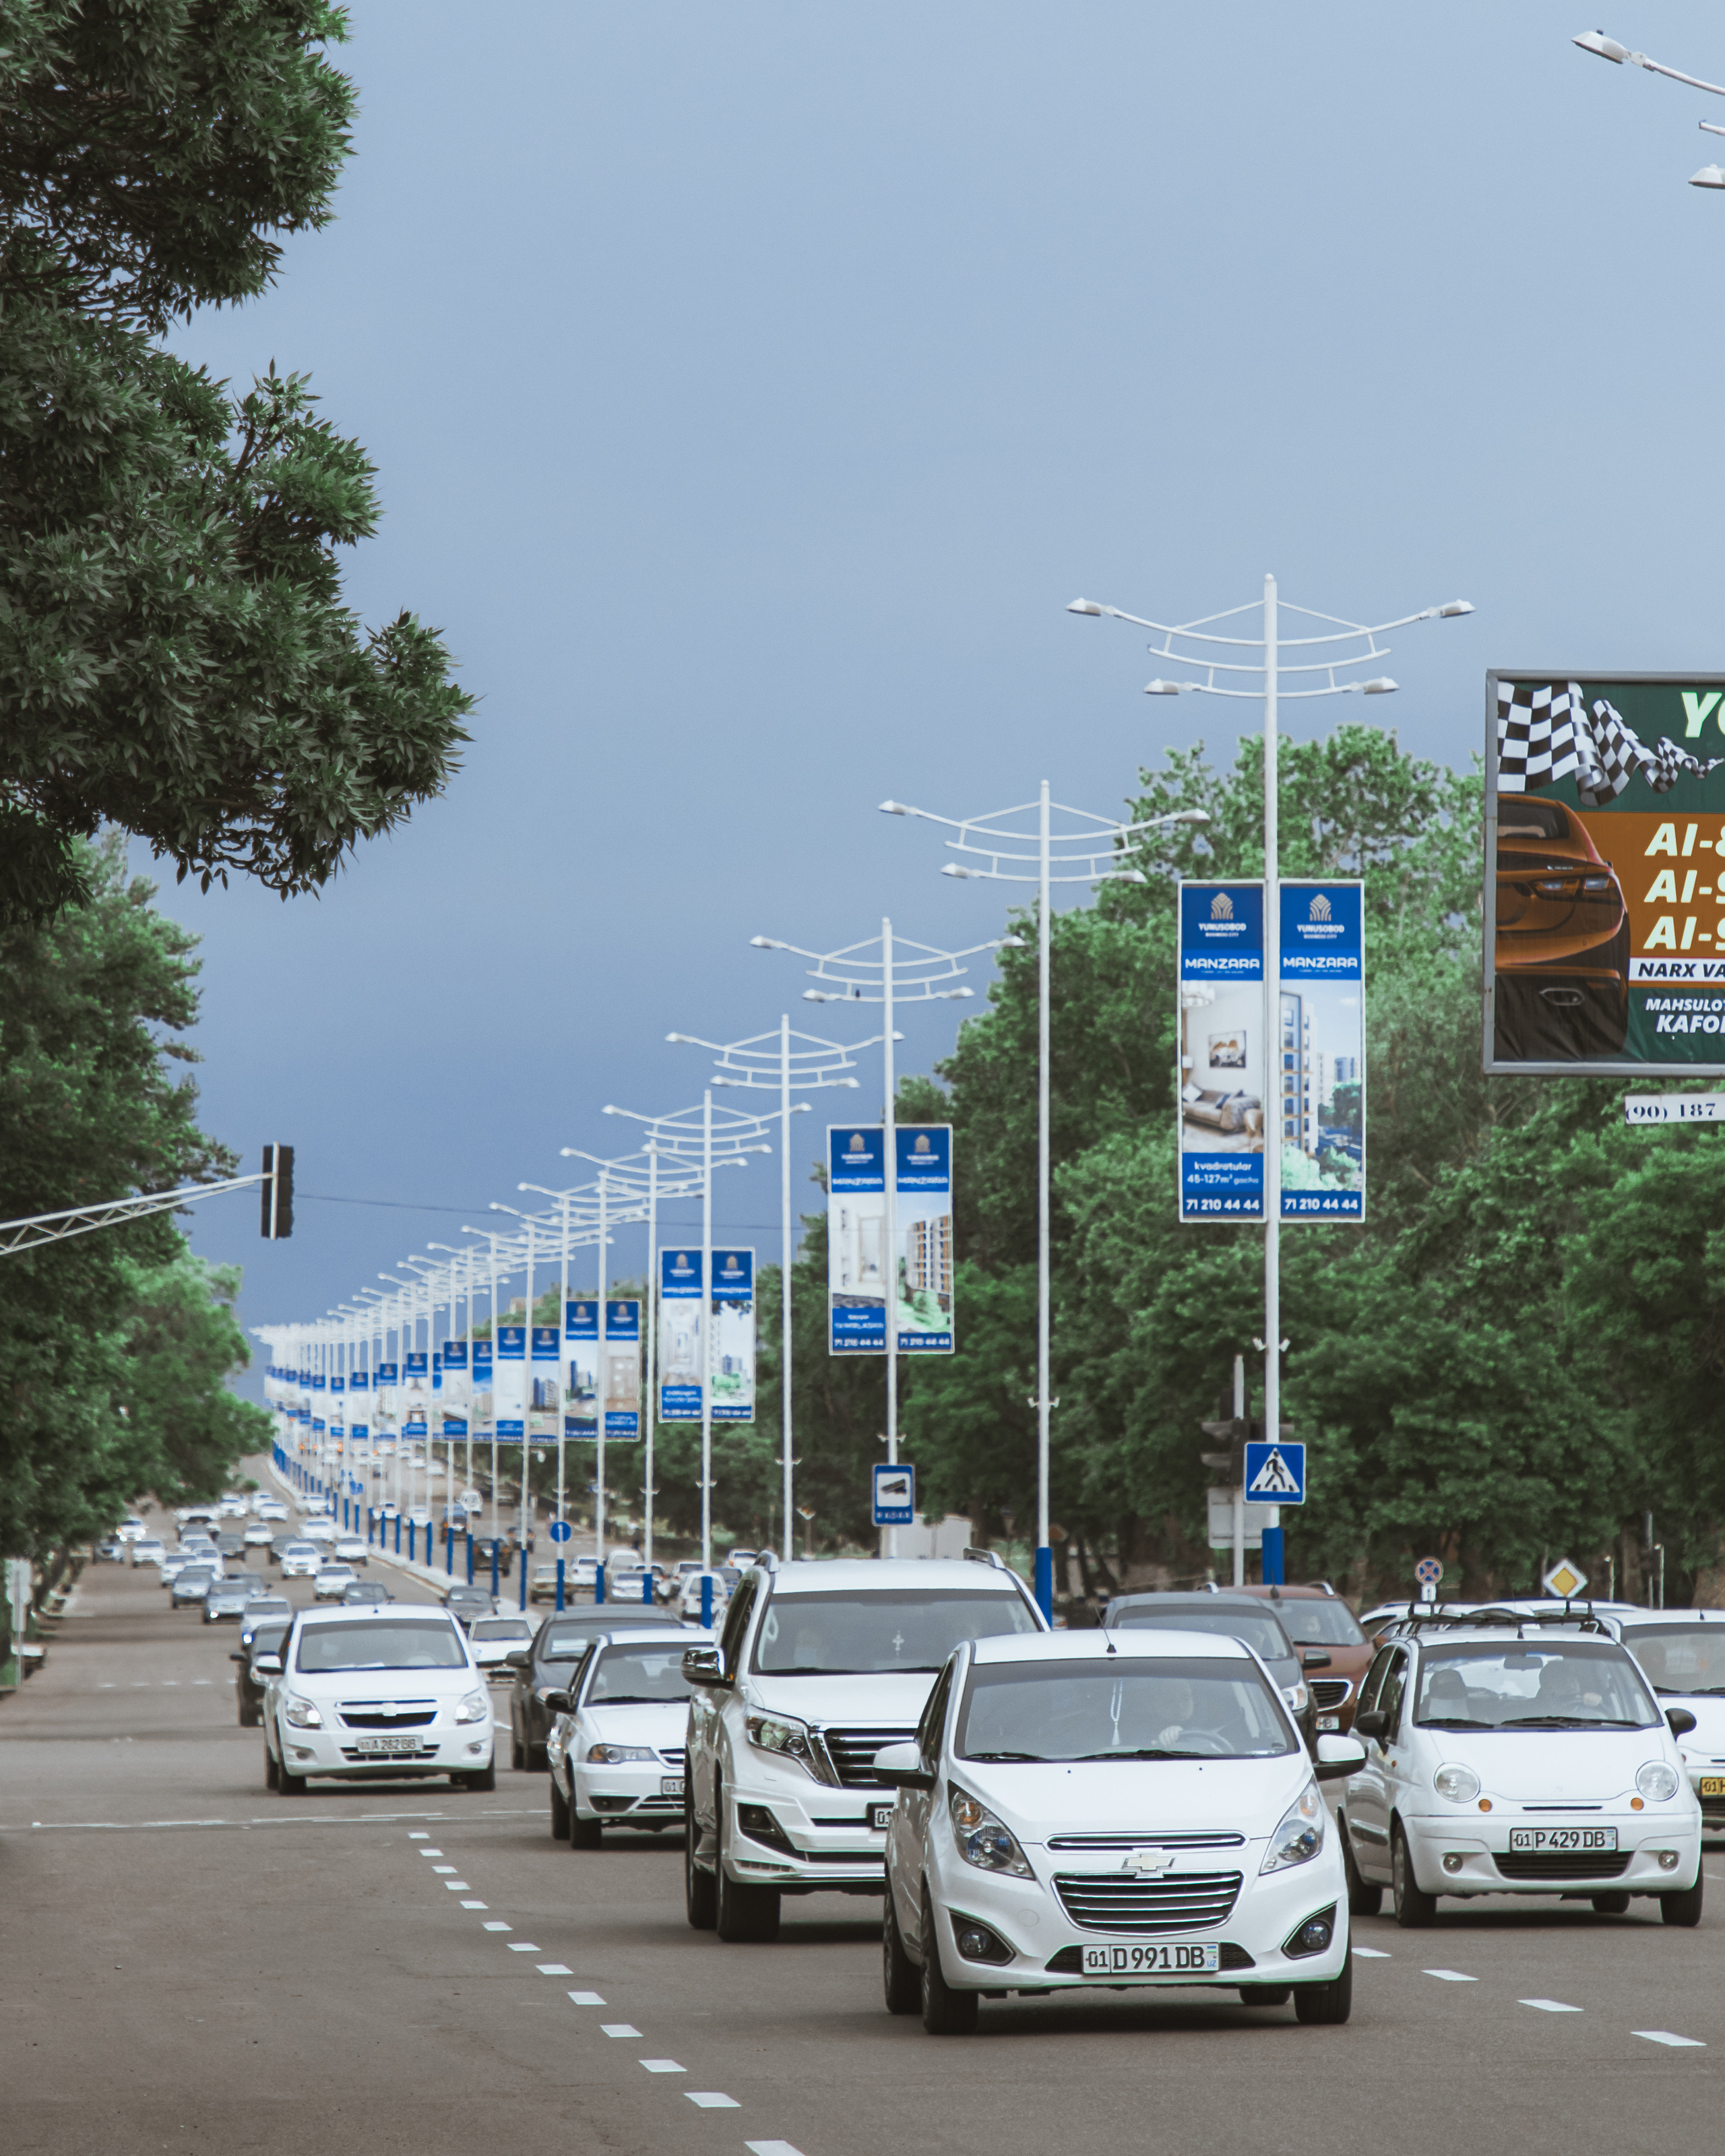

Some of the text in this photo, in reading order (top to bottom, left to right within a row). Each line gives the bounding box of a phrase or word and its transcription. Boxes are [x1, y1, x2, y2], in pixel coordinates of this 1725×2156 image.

[1681, 691, 1725, 738] Y
[1185, 958, 1260, 969] MANZARA
[1283, 957, 1358, 968] MANZARA
[1638, 963, 1697, 978] NARX
[1645, 998, 1725, 1011] MAHSULO
[1625, 1103, 1716, 1123] (90) 187
[1186, 1199, 1259, 1211] 71 210 44 44
[1284, 1198, 1358, 1210] 71 210 44 44
[1704, 1781, 1717, 1792] 01
[1516, 1833, 1531, 1846] 01
[1534, 1831, 1546, 1848] P
[1549, 1831, 1579, 1848] 429
[1583, 1831, 1605, 1848] DB
[1088, 1946, 1217, 1969] 01 D 991 DB UZ
